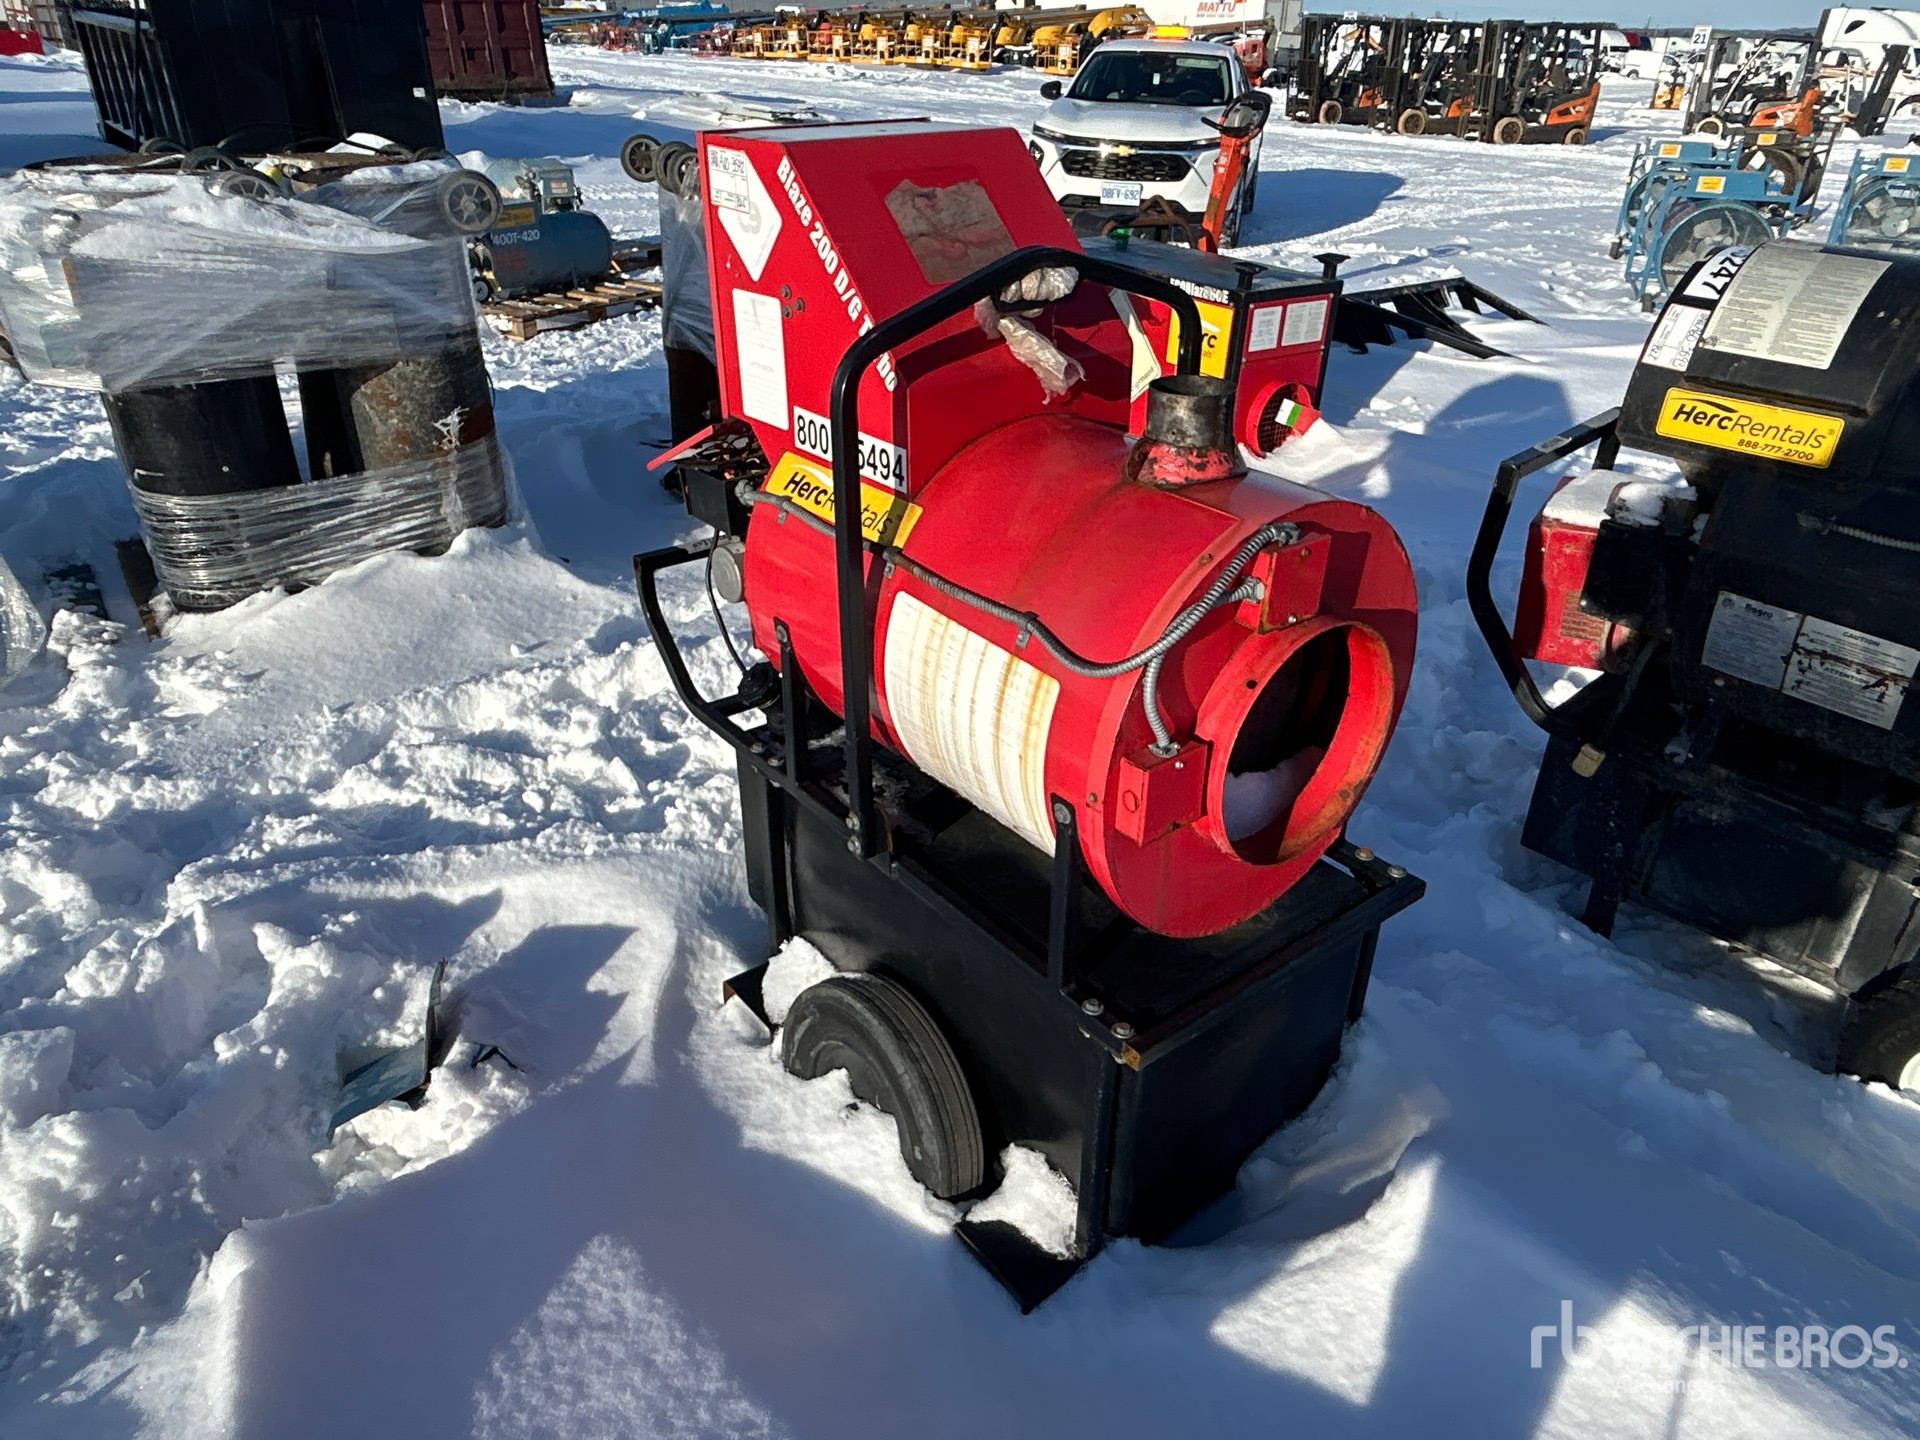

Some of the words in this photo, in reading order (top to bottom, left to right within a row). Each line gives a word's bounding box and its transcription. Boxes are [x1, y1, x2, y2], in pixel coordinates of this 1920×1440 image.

[1197, 1, 1237, 13] MATTU
[1692, 33, 1707, 45] 21
[490, 229, 541, 246] 400T-420
[776, 155, 812, 227] Blaze
[809, 221, 839, 275] 200
[833, 273, 864, 323] D/G
[857, 314, 899, 392] Tbo
[1672, 403, 1828, 450] HercRentals
[796, 414, 905, 487] 8005494
[1737, 437, 1815, 462] 888-777-2700
[783, 470, 893, 534] HercRtals
[1842, 631, 1881, 647] CAUTION
[1824, 667, 1871, 684] ATTENTION
